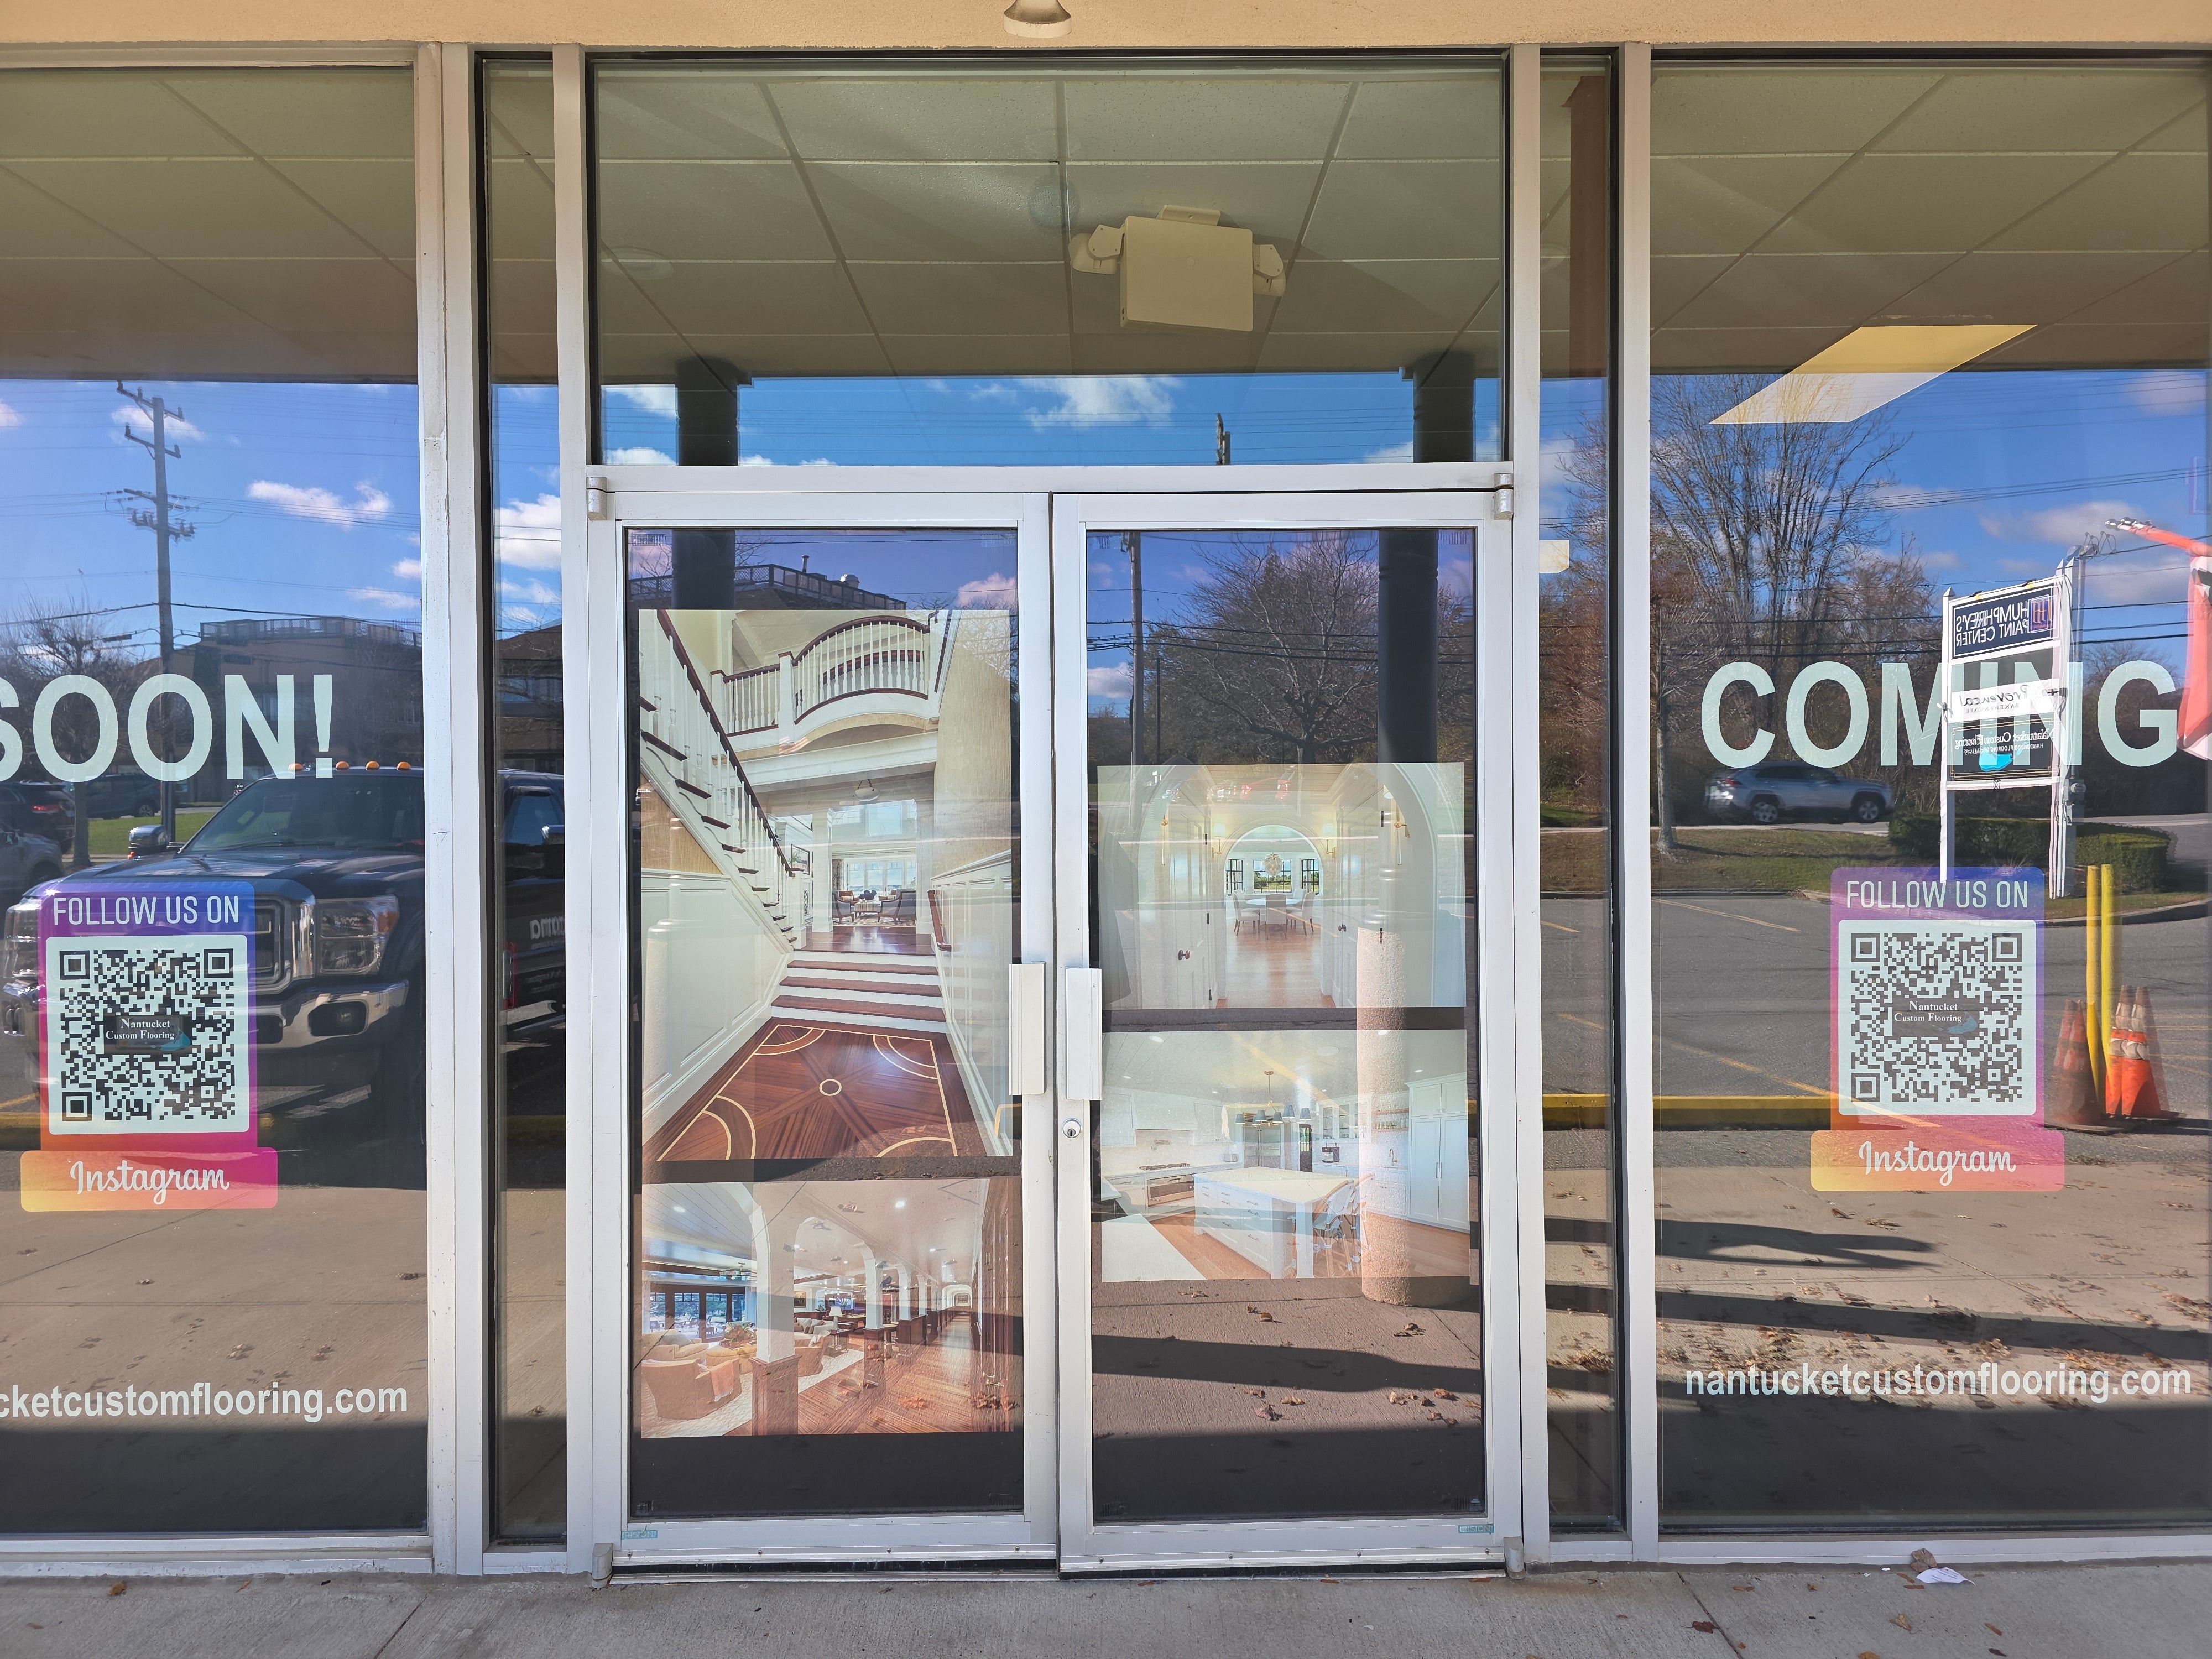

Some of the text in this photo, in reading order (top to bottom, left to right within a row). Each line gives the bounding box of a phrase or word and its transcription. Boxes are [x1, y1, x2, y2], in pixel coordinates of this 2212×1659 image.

[1701, 660, 2178, 768] COMING
[1846, 880, 2028, 909] FOLLOW US ON
[53, 895, 239, 926] FOLLOW US ON
[1894, 1013, 1962, 1023] Custom Flooring
[1908, 1000, 1958, 1011] Nantucket
[105, 1030, 175, 1040] Custom Flooring
[120, 1018, 170, 1028] Nantucket
[1858, 1140, 2016, 1186] Instagram
[70, 1159, 230, 1206] Instagram
[1686, 1362, 2191, 1404] nantucketcustomflooring.com
